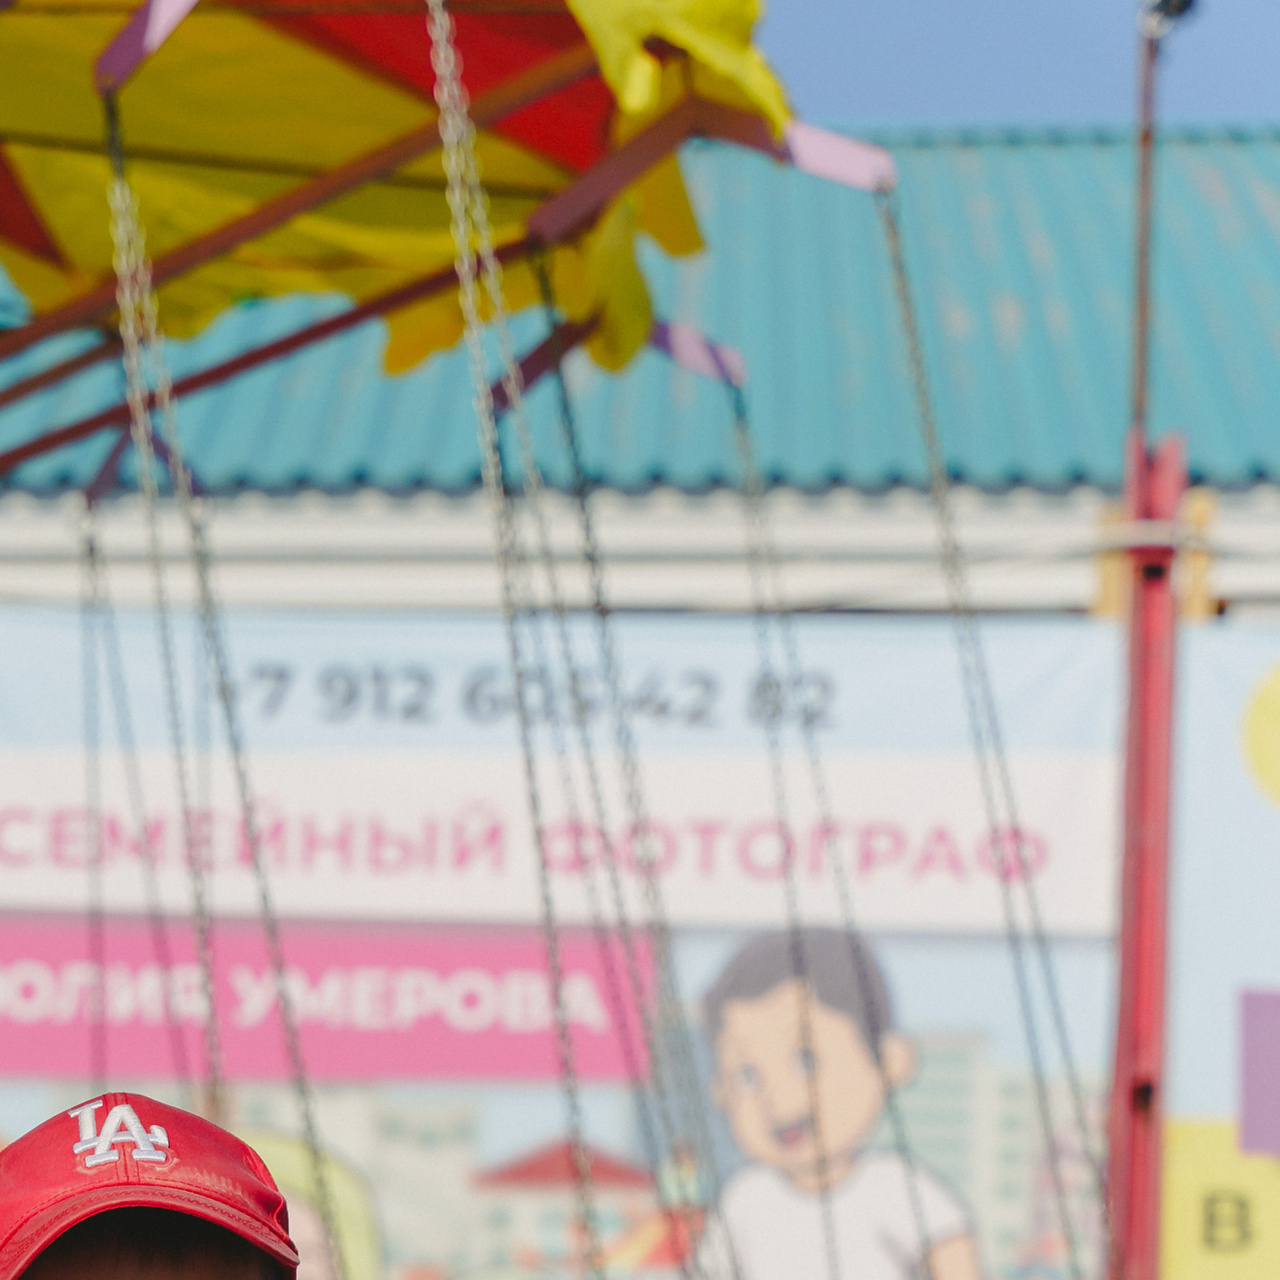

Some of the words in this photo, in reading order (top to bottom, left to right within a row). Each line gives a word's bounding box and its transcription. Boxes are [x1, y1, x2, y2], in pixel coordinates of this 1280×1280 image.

[315, 662, 435, 725] 912
[543, 818, 1049, 881] ФОТОГРАФ
[228, 962, 614, 1035] УМЕРОВА
[68, 1100, 169, 1168] LA
